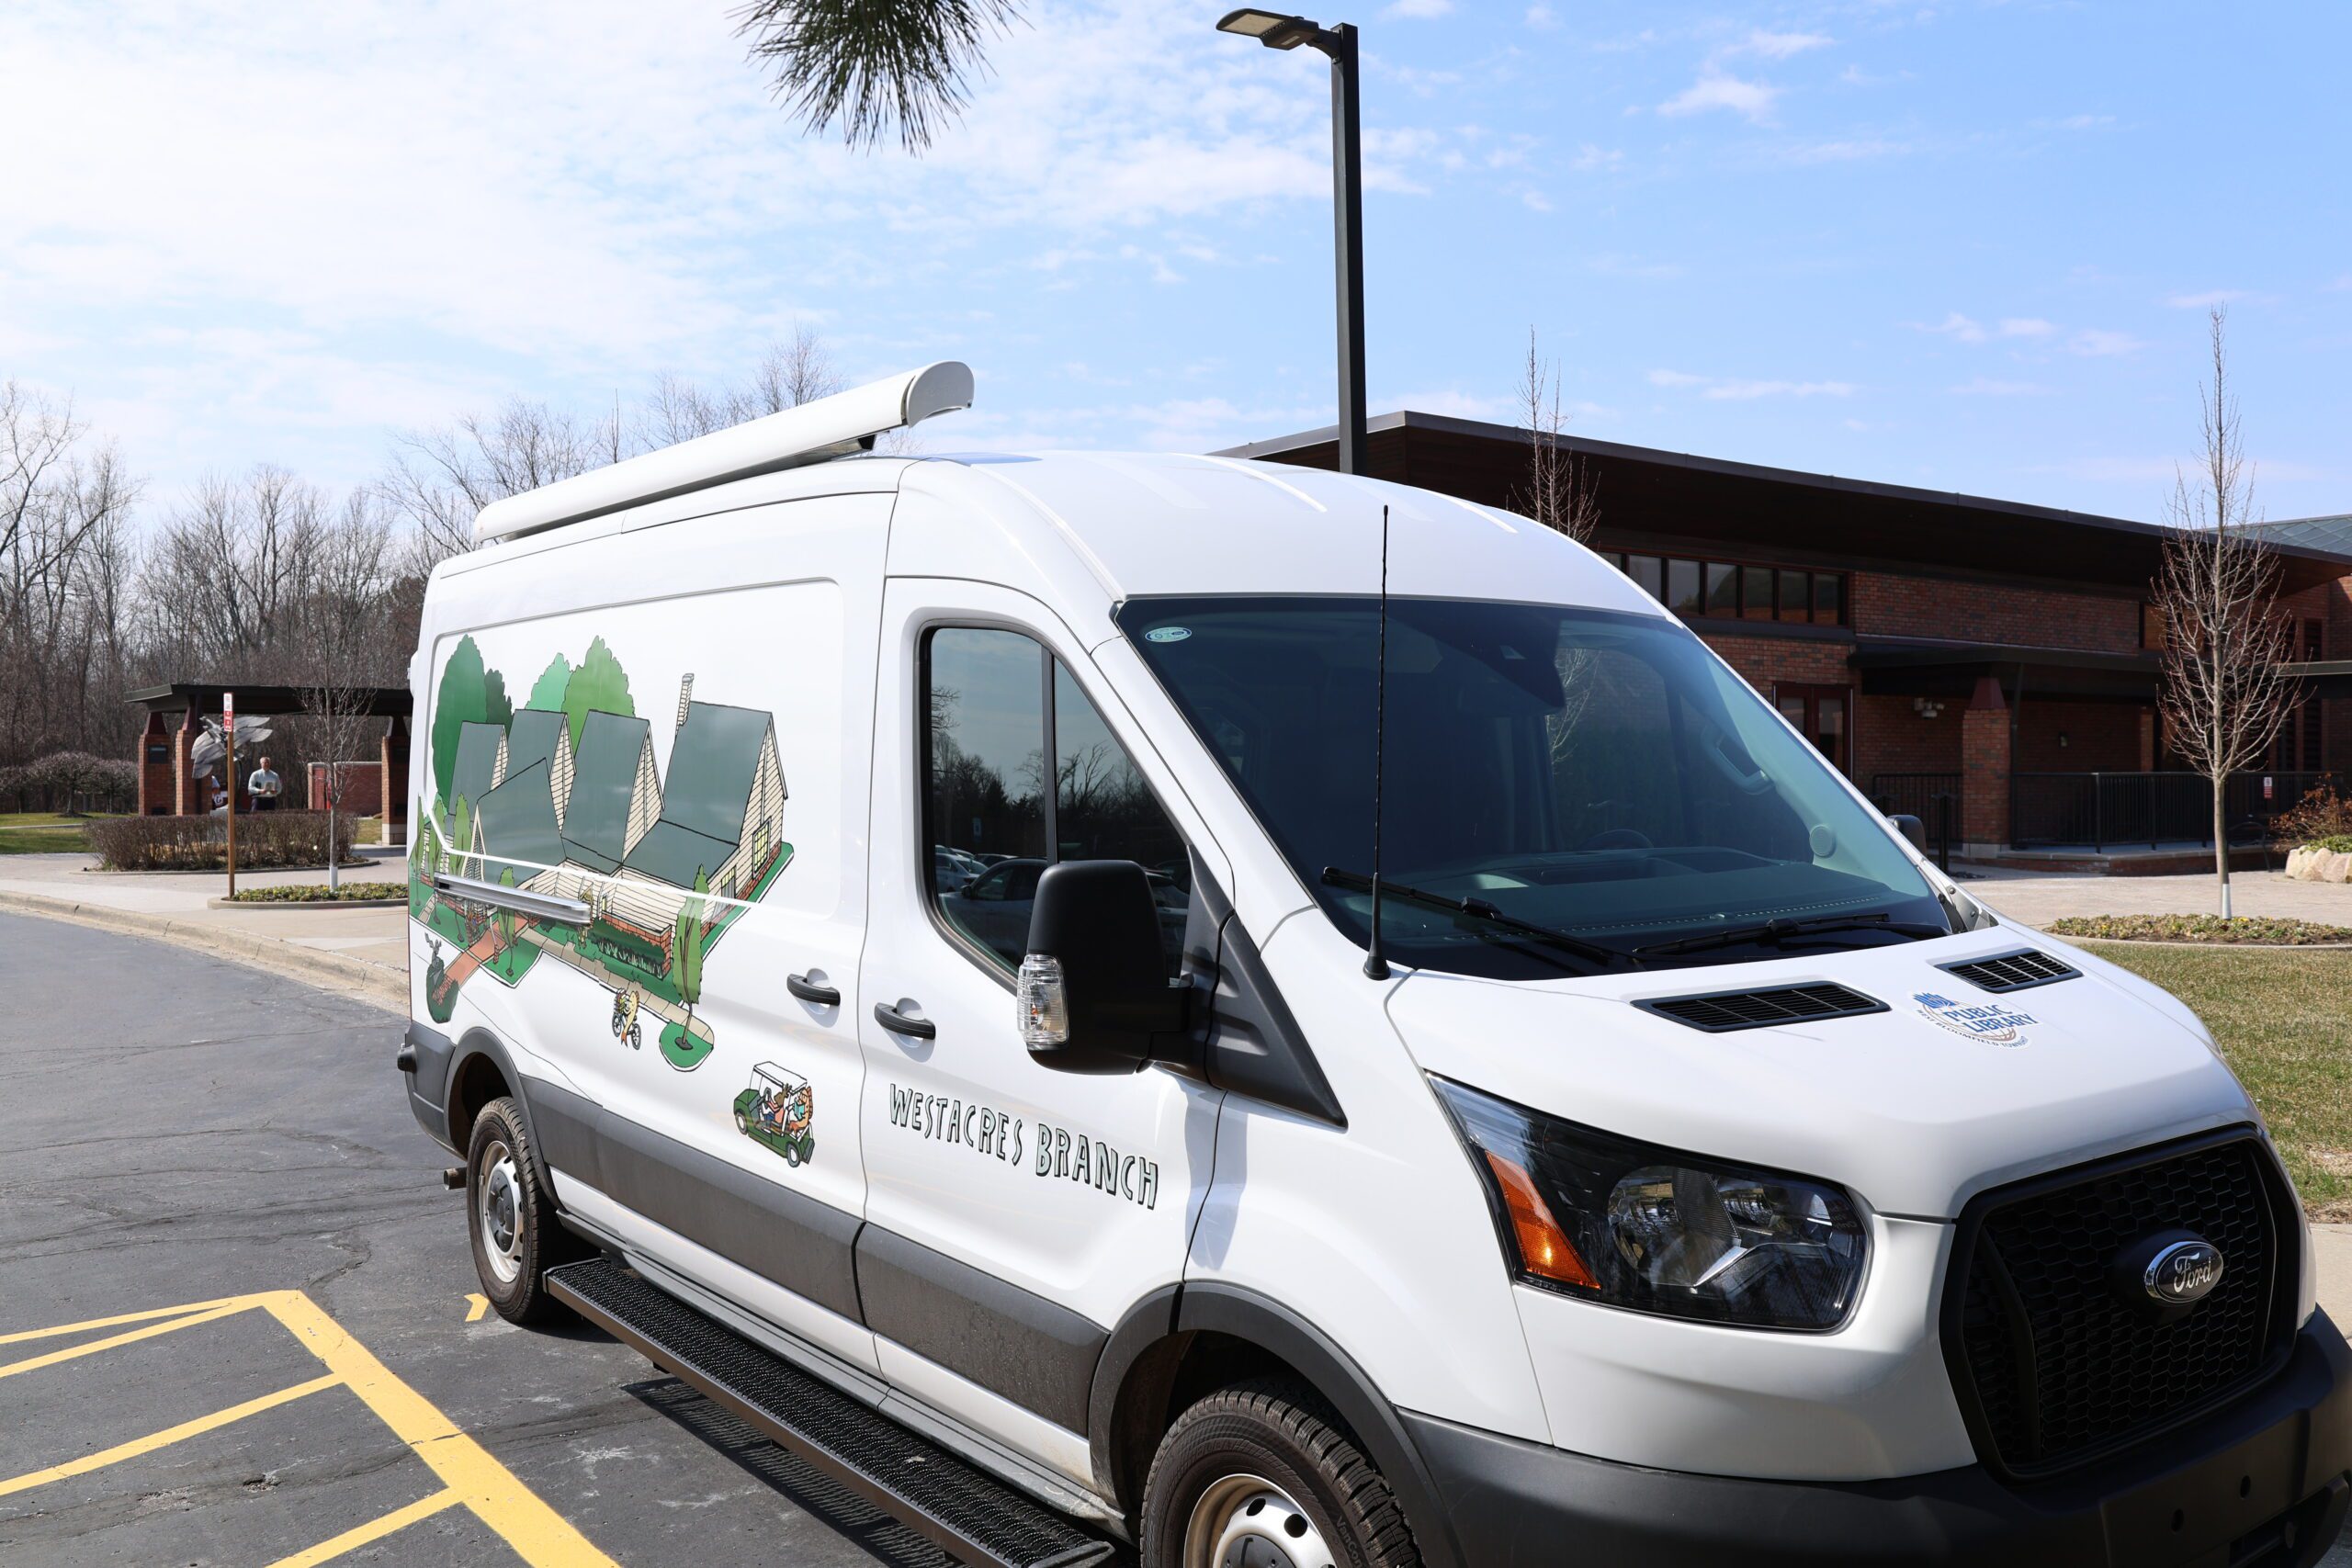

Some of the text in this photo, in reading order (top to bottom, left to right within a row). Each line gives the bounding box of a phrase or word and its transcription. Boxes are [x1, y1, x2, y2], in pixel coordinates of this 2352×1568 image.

[1942, 1005, 2013, 1021] PUBLIC
[1962, 1013, 2039, 1032] LIBRARY
[889, 1083, 1159, 1211] WESTACRES BRANCH
[2174, 1252, 2213, 1293] Ford
